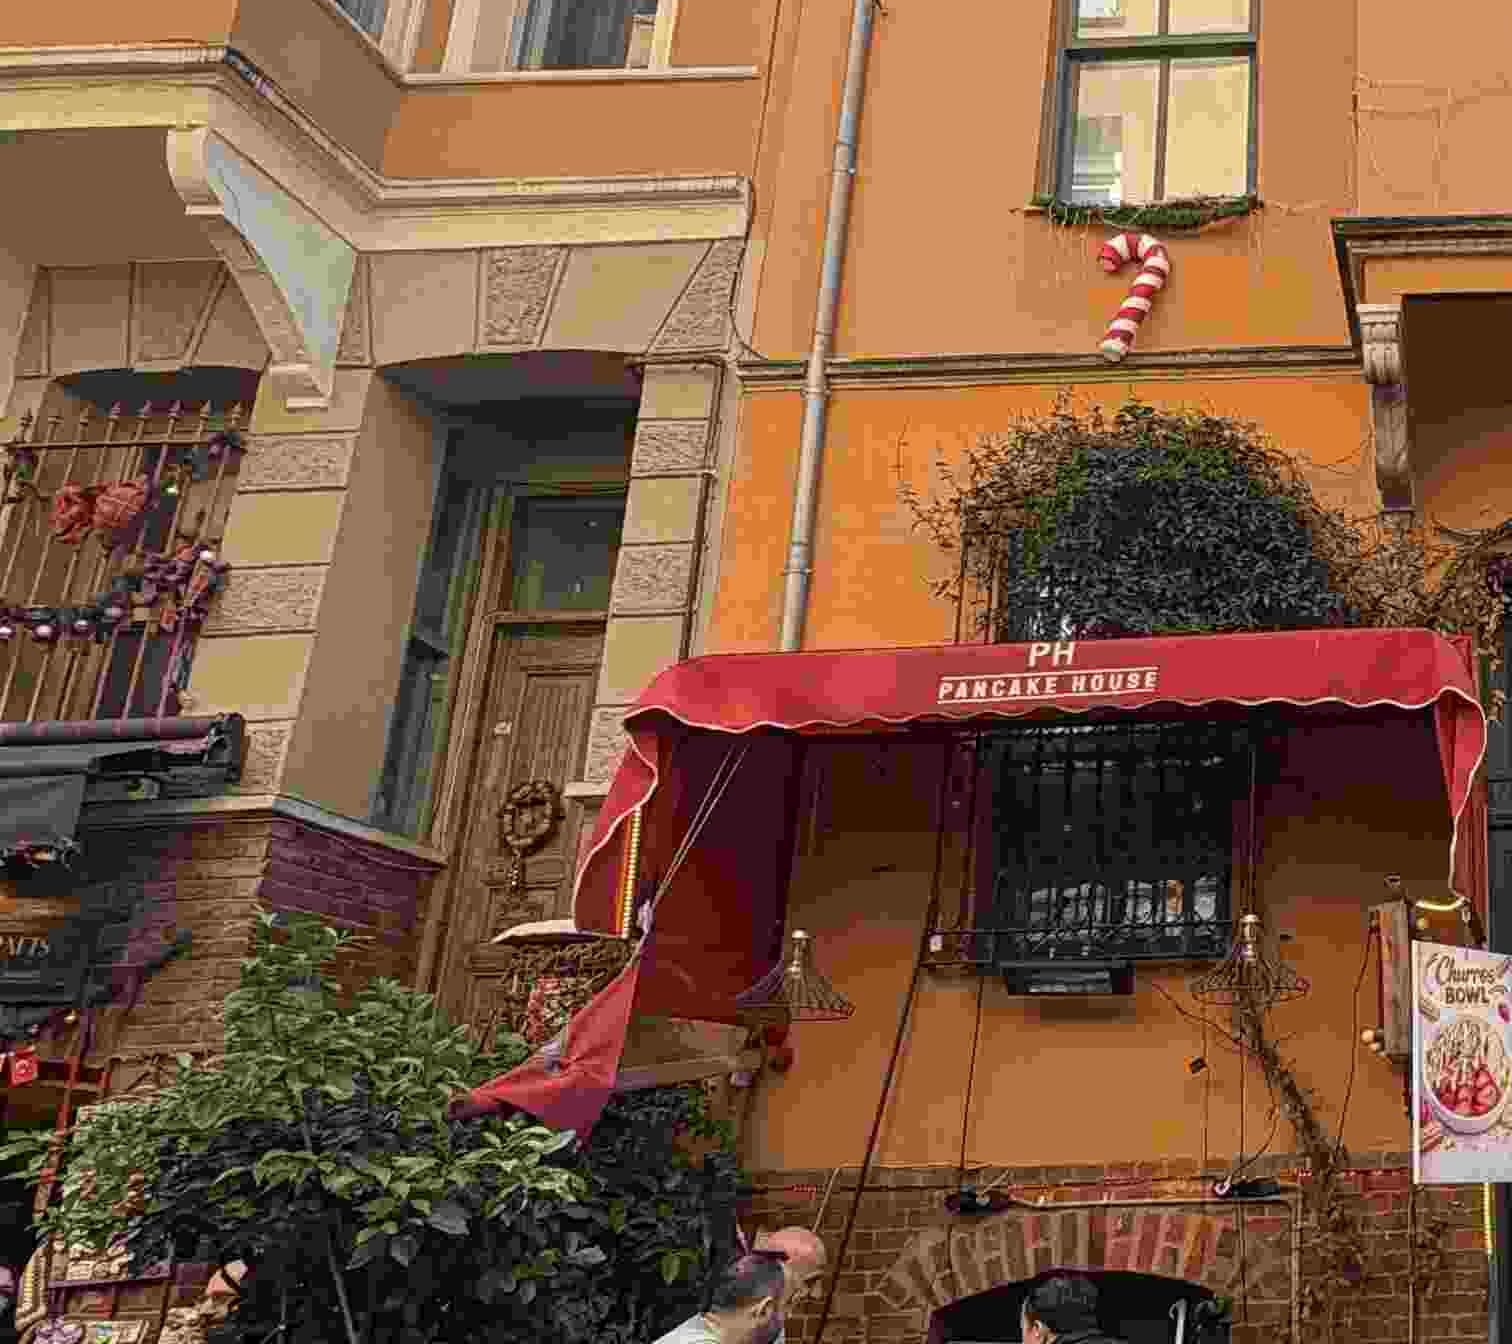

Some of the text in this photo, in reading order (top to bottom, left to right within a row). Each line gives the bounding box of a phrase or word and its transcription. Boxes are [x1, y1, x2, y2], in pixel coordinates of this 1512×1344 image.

[1028, 641, 1076, 667] PH
[938, 671, 1158, 699] PANCAKE HOUSE
[1445, 985, 1490, 1004] BOWL
